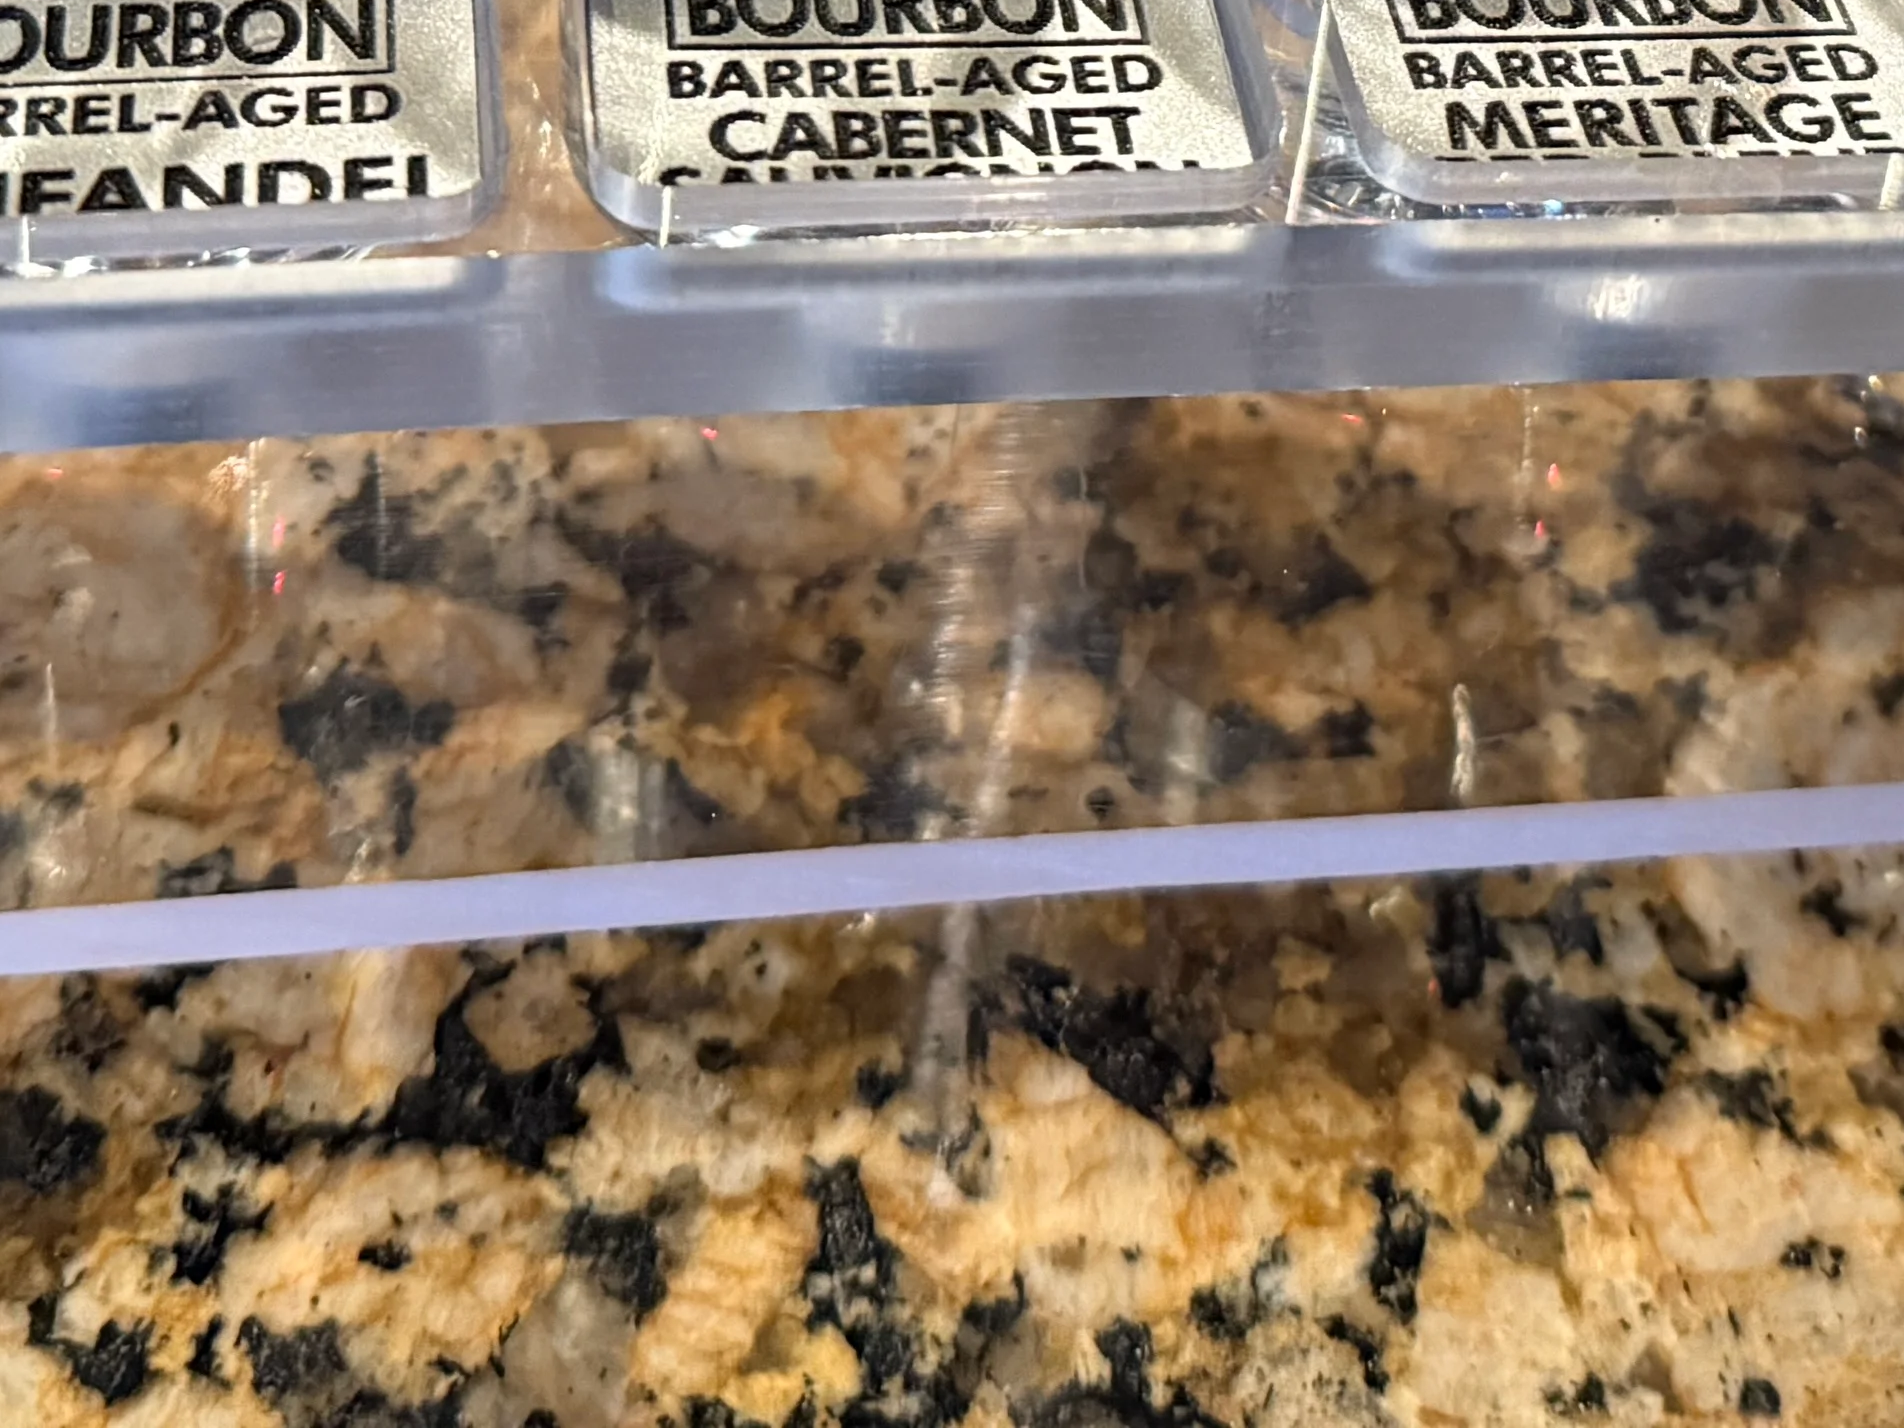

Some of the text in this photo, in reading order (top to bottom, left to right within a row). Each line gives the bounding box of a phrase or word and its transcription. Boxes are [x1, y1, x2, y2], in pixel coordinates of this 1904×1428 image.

[666, 52, 1165, 101] BARREL-AGED
[1402, 42, 1880, 91] BARREL-AGED
[706, 104, 1141, 162] CABERNET
[1444, 90, 1893, 152] MERITAGE
